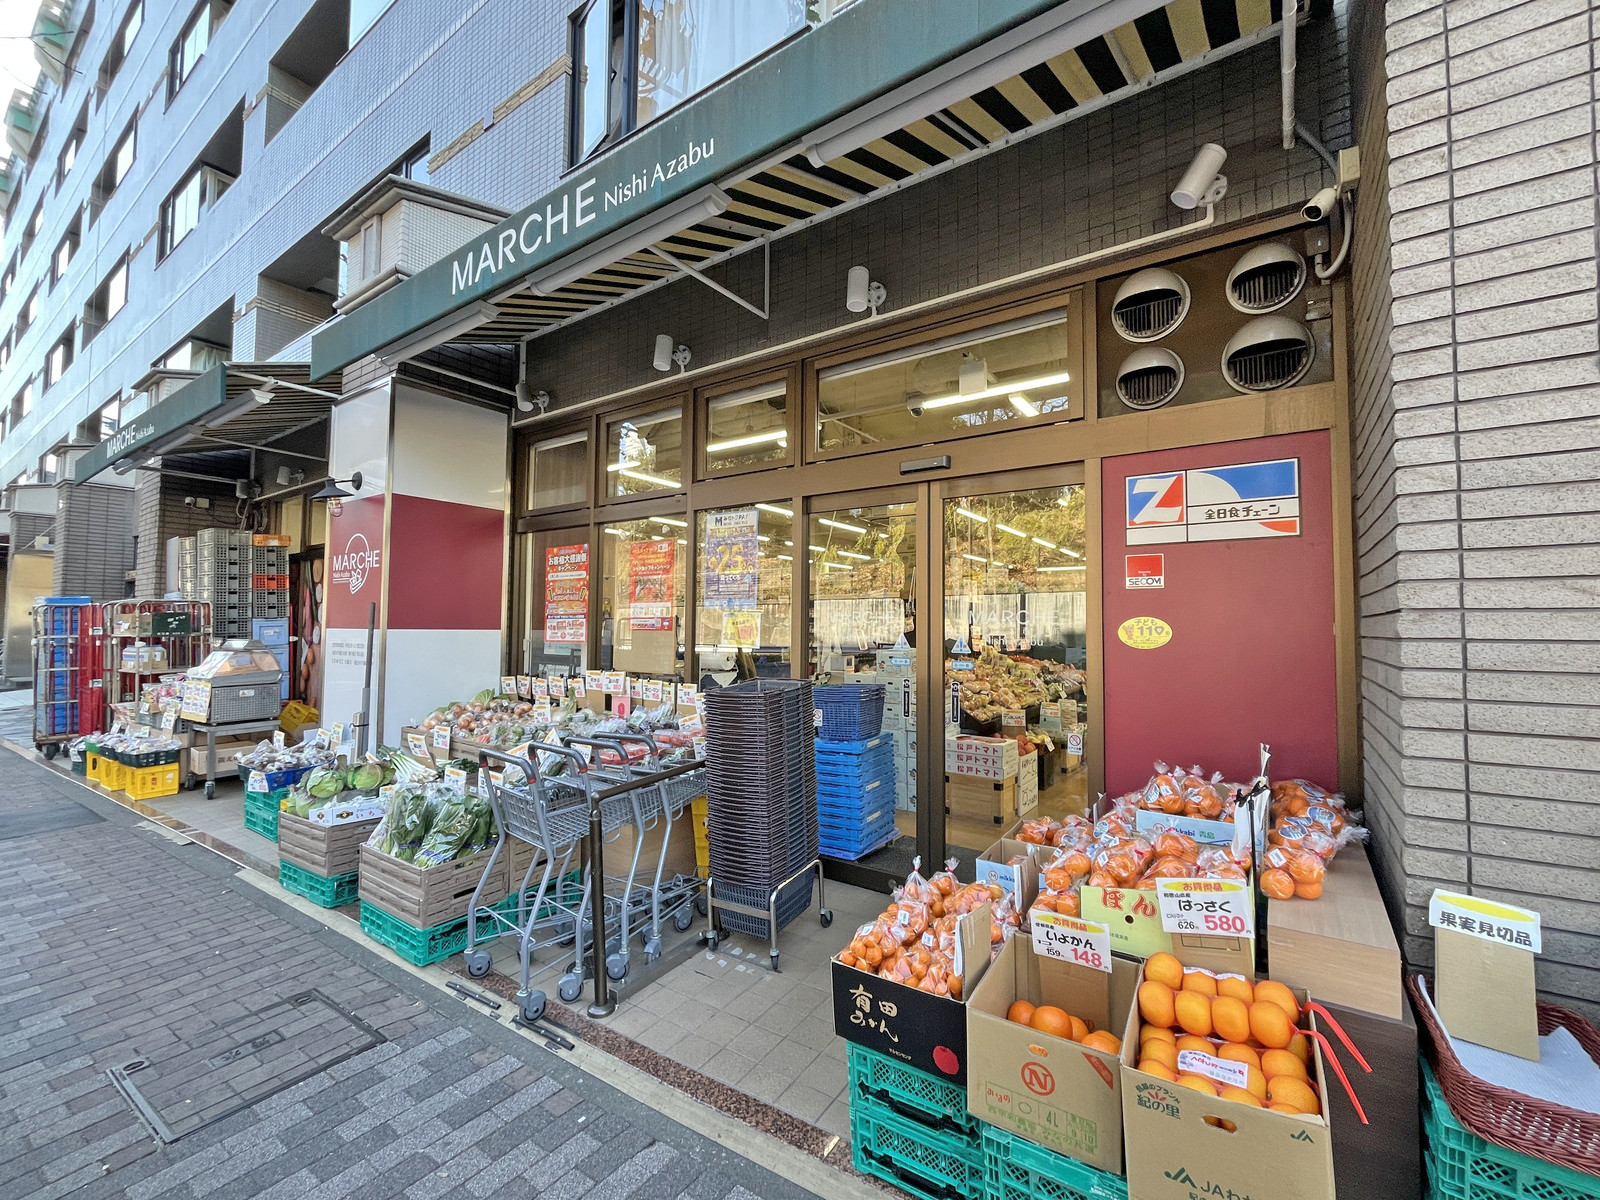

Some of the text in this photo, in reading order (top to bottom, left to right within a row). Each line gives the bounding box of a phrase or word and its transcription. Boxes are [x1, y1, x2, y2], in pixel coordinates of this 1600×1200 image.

[451, 137, 715, 296] MARCHE Nishi Azabu
[106, 424, 137, 459] MARCHE
[1204, 504, 1280, 521] 全日食チェーン
[332, 549, 381, 571] MARCHE
[1128, 577, 1162, 586] SECOM
[1134, 618, 1158, 627] 子ども
[956, 742, 999, 755] 松戸トマト
[956, 754, 999, 767] 松戸トマト
[956, 764, 999, 778] 松戸トマト
[1182, 882, 1224, 892] お買得品
[1178, 899, 1232, 914] はっさく
[1052, 917, 1089, 933] お買得品
[1177, 921, 1195, 930] 626
[1203, 914, 1246, 933] 580
[1439, 911, 1533, 948] 果実見切品
[1045, 930, 1096, 951] いよかん
[1046, 948, 1061, 957] 159
[1070, 947, 1103, 969] 148
[849, 983, 898, 1018] 有田
[849, 1010, 899, 1043] みかん
[1026, 1067, 1050, 1091] N
[1136, 1094, 1182, 1120] 紀の里
[1046, 1110, 1059, 1129] 4L
